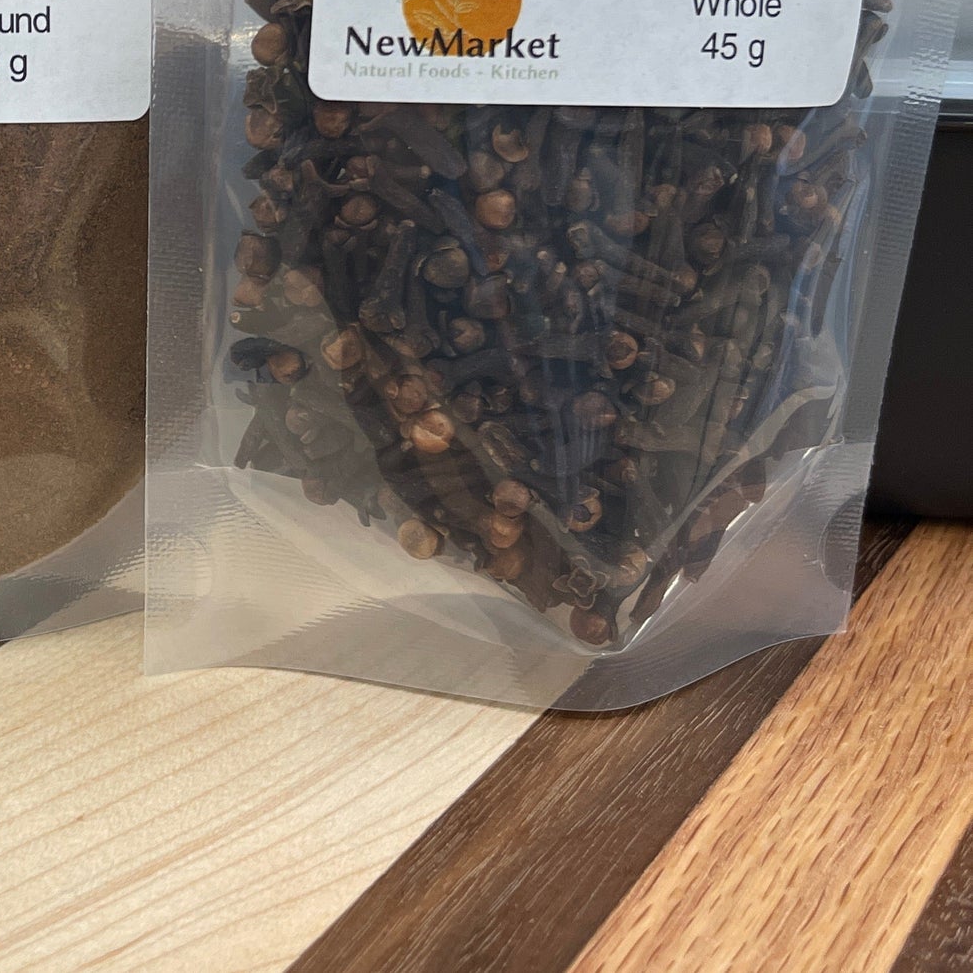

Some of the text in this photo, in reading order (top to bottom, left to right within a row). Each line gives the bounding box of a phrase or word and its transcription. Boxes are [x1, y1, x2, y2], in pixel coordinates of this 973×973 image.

[345, 26, 560, 59] NewMarket
[700, 32, 765, 68] 45 g
[9, 54, 28, 83] g
[343, 61, 412, 79] Natural
[418, 63, 470, 79] Foods
[490, 64, 560, 81] Kitchen
